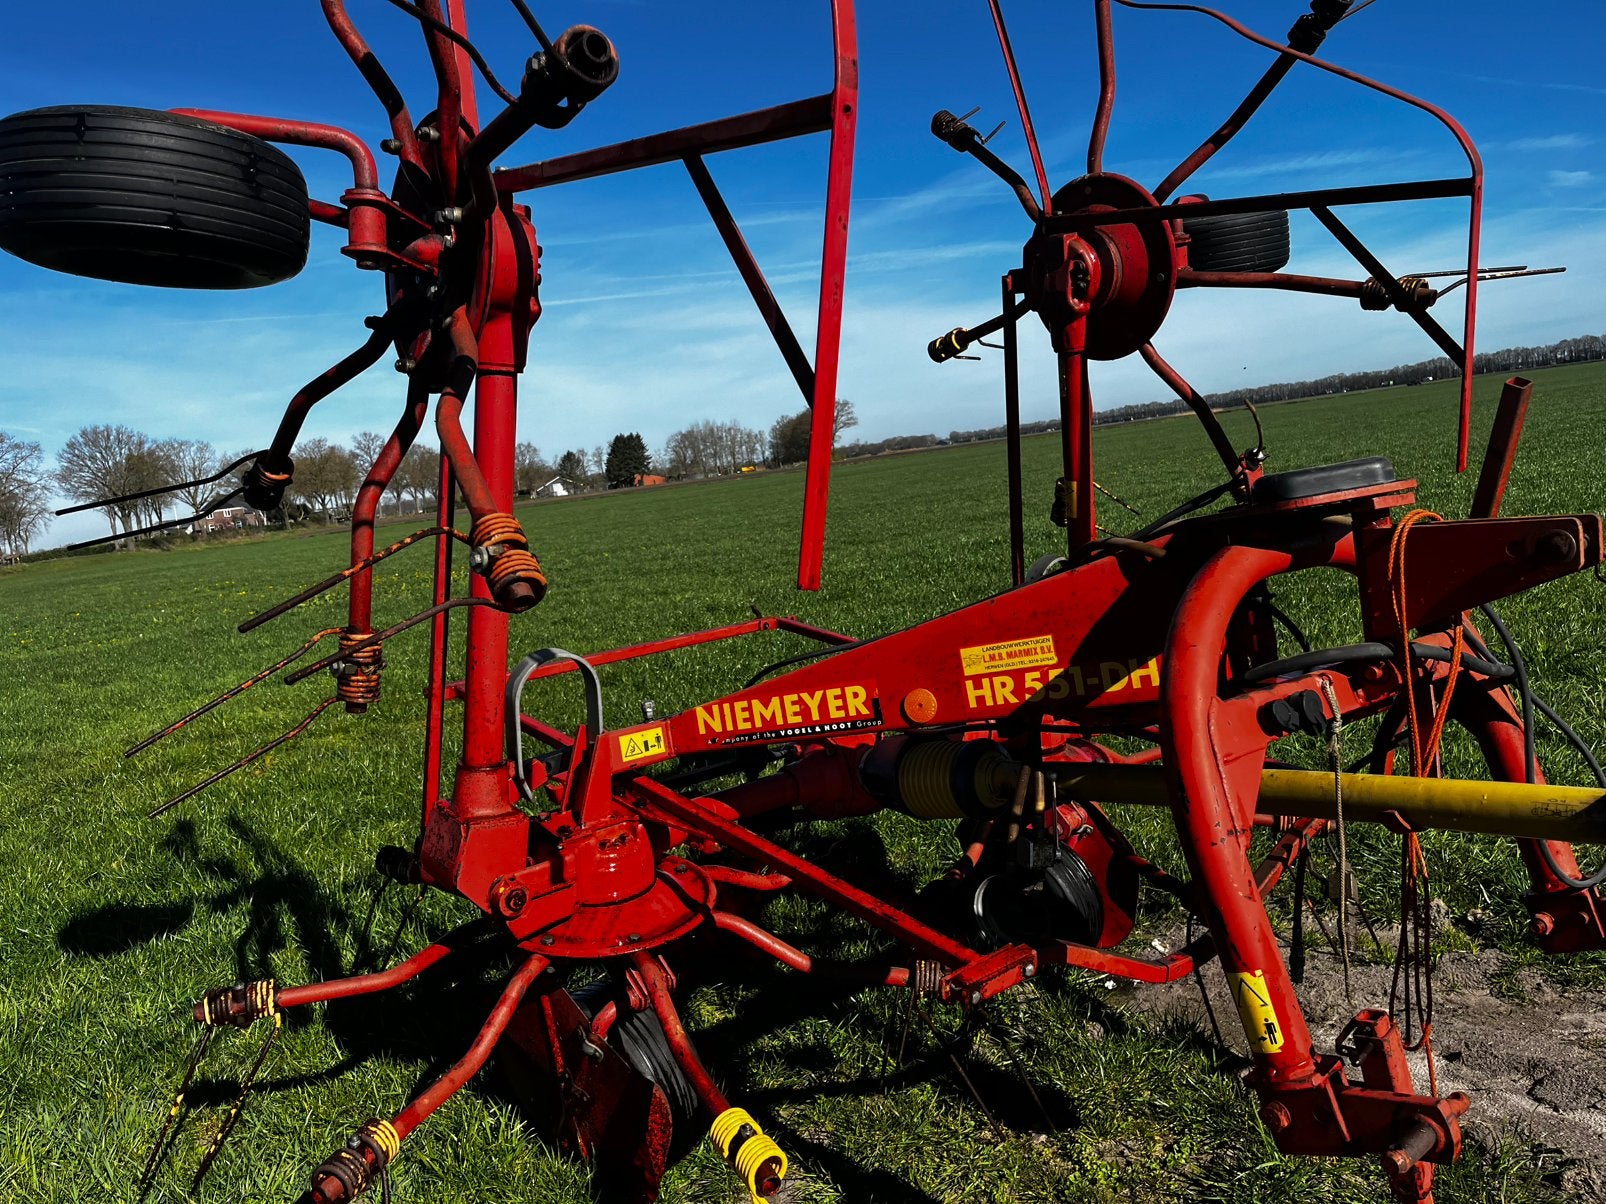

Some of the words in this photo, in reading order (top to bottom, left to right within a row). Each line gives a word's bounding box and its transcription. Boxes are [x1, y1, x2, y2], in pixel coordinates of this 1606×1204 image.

[981, 637, 1051, 653] LANDBOUWWERKTUIGEN
[1005, 646, 1039, 660] MARMIX
[965, 675, 1019, 709] HR
[1024, 656, 1160, 702] 551-DH
[695, 685, 871, 735] NIEMEYER
[780, 727, 812, 736] VOGEL
[824, 722, 852, 731] NOOT
[856, 720, 882, 728] Group
